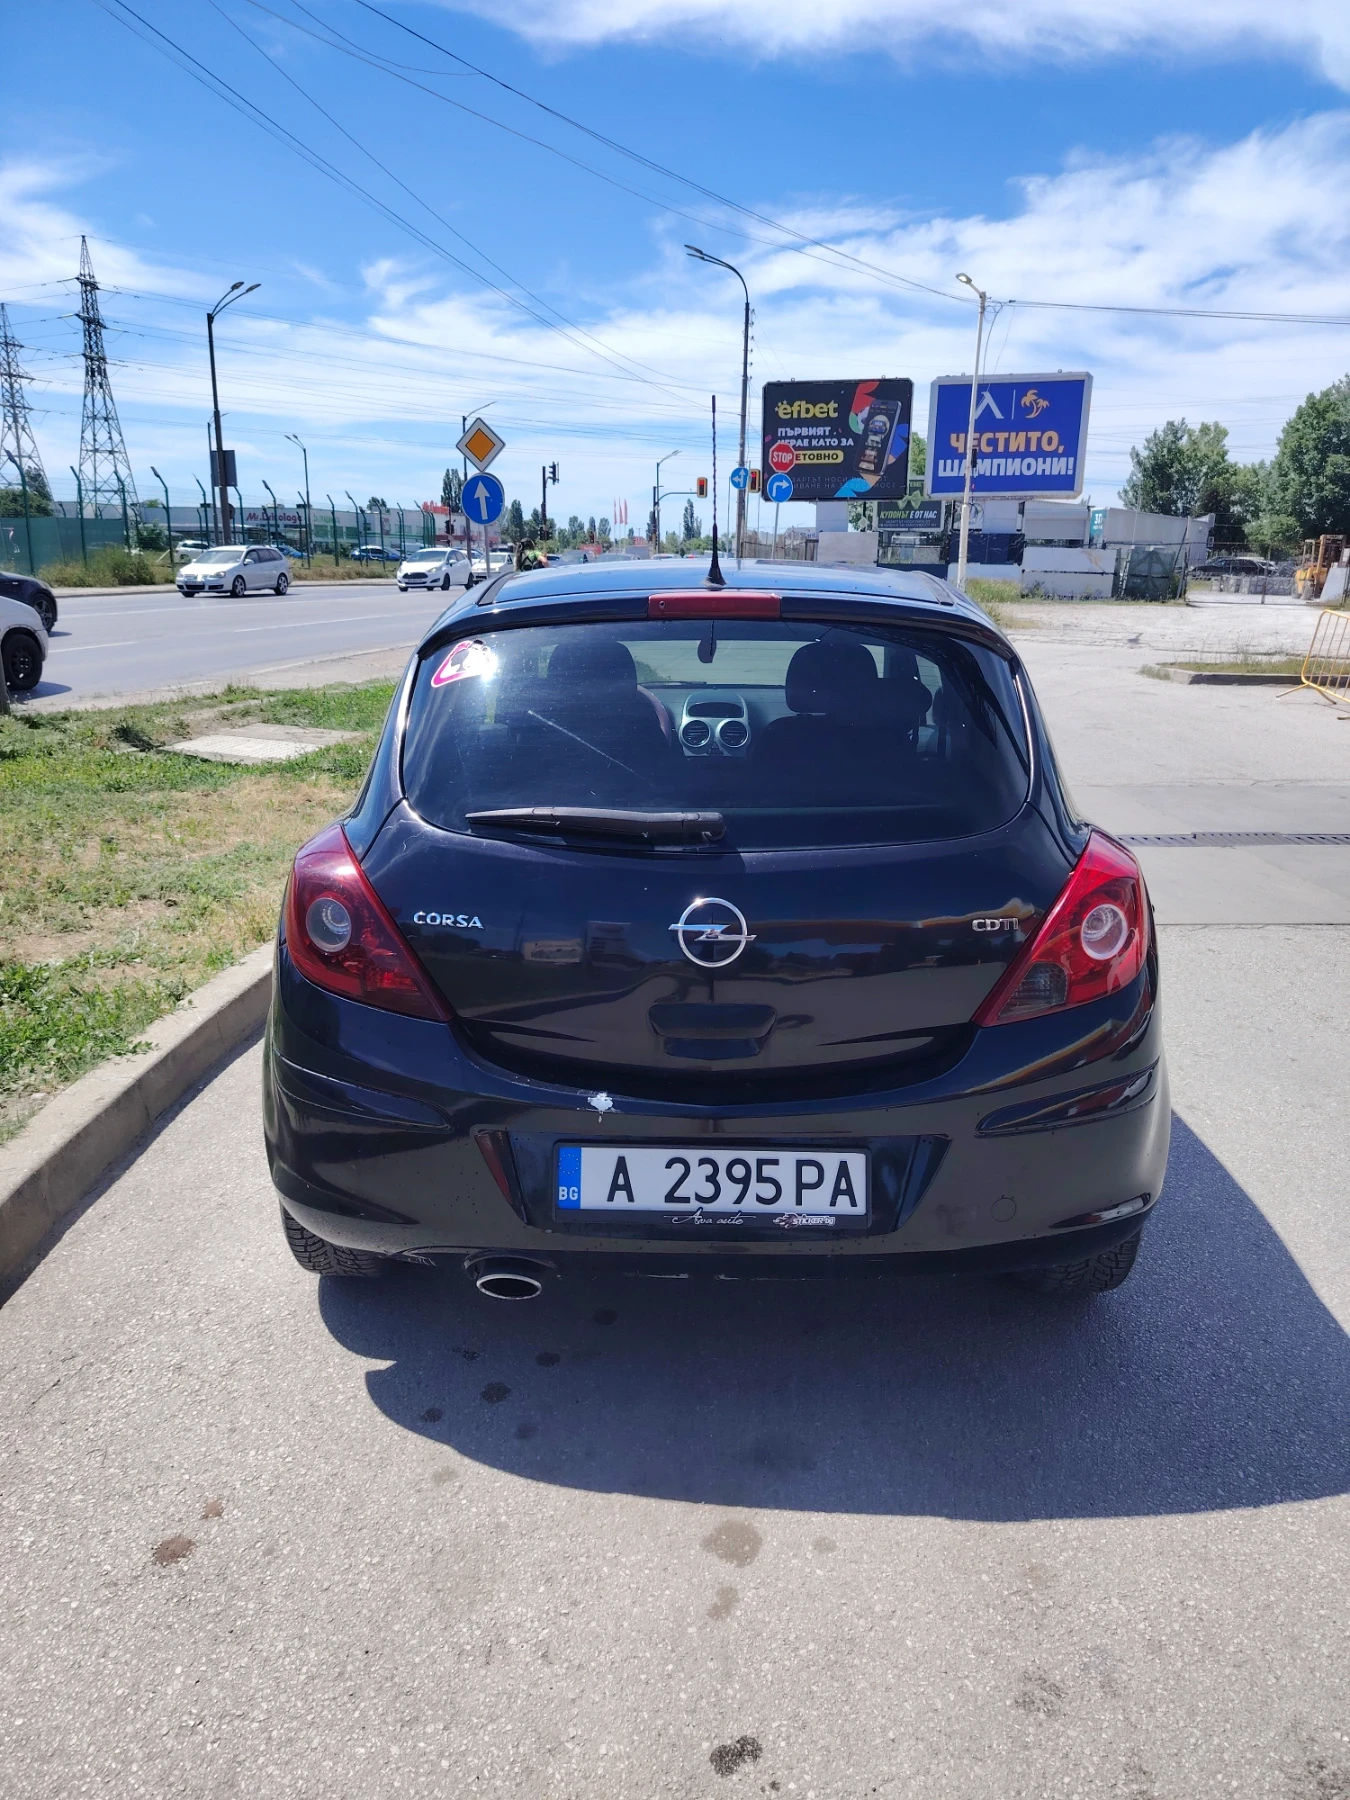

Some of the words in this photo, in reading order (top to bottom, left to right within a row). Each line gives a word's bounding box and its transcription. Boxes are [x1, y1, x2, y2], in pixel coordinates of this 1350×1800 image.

[777, 400, 839, 419] efbet
[778, 427, 832, 437] ПЪРВИЯТ
[812, 438, 838, 447] КАТО
[841, 438, 854, 446] ЗА
[950, 431, 1065, 454] ЧЕСТИТО,
[772, 452, 793, 463] STOP
[938, 457, 1075, 477] ШАМПИОНИ!
[923, 510, 938, 518] НАС
[413, 911, 485, 929] CORSA
[971, 917, 1019, 931] CDTI
[606, 1155, 635, 1203] A
[664, 1156, 783, 1206] 2395
[795, 1158, 858, 1208] PA
[558, 1186, 578, 1201] BG
[716, 1210, 757, 1225] auto
